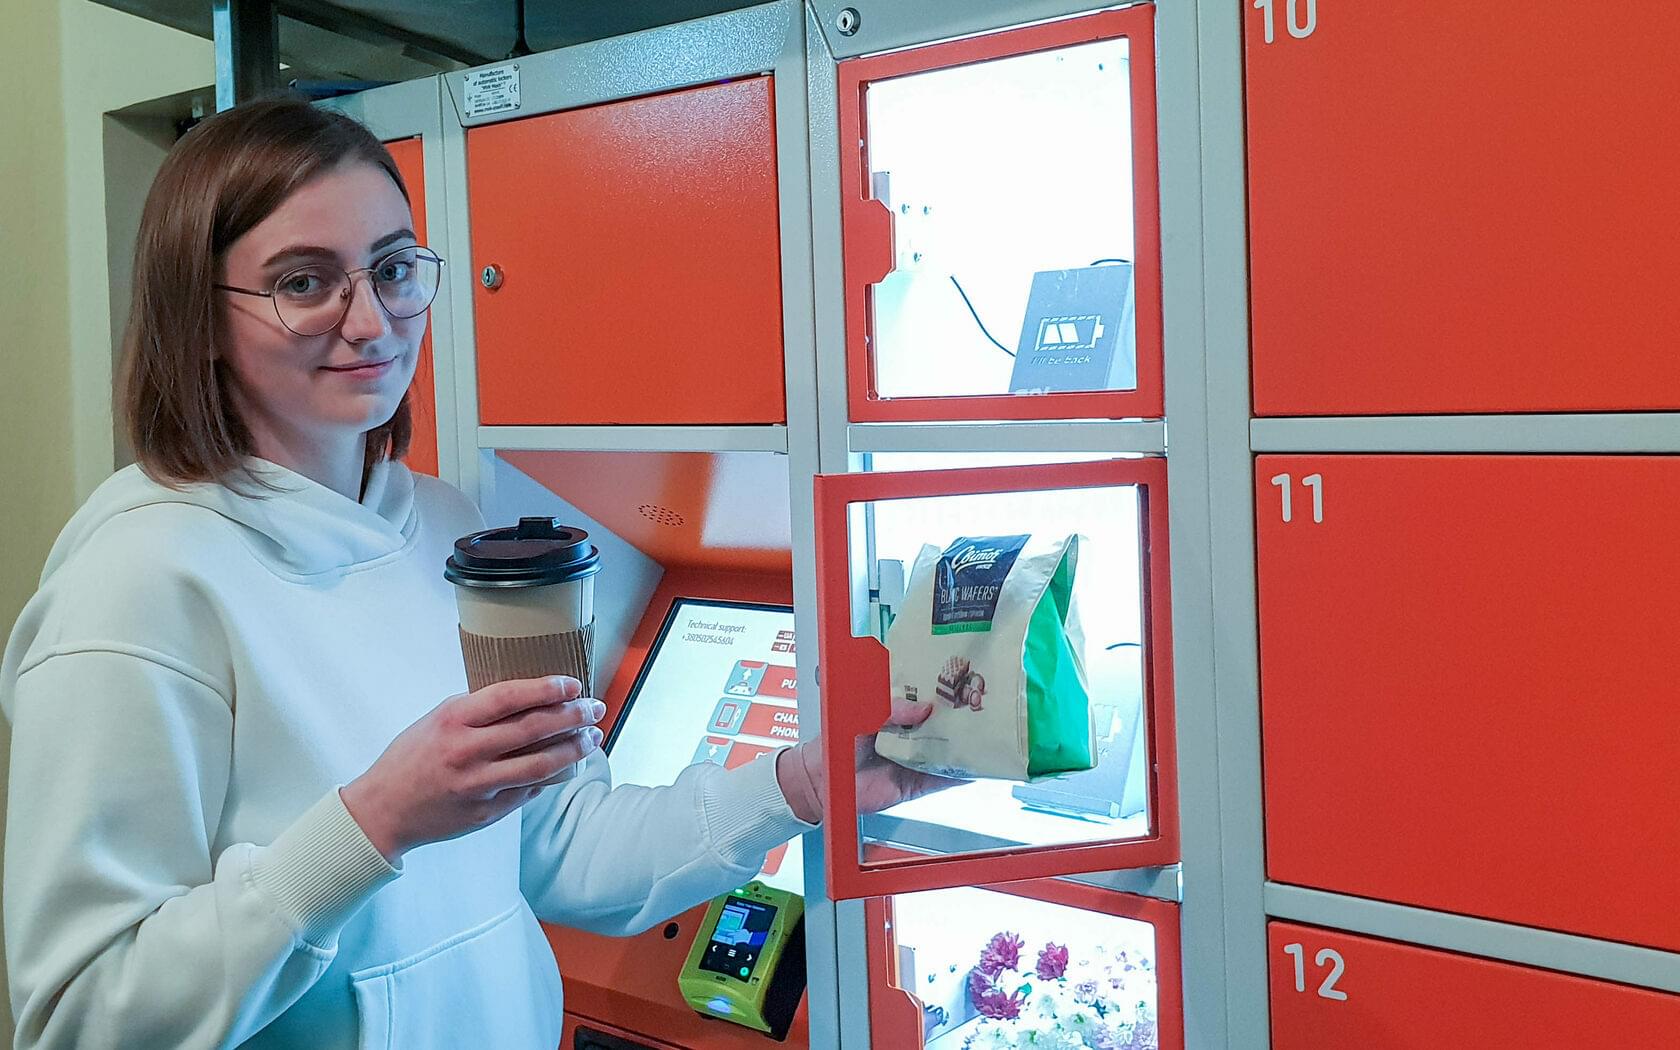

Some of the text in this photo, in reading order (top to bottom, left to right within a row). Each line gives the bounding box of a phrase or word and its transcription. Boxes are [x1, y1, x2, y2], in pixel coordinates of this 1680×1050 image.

[1253, 0, 1317, 44] 10
[1064, 355, 1091, 364] back
[1271, 473, 1323, 523] 11
[961, 585, 995, 601] WAFERS
[687, 619, 746, 634] Technical support:
[781, 678, 797, 689] PU
[770, 725, 799, 738] PHON
[1283, 943, 1347, 1001] 12
